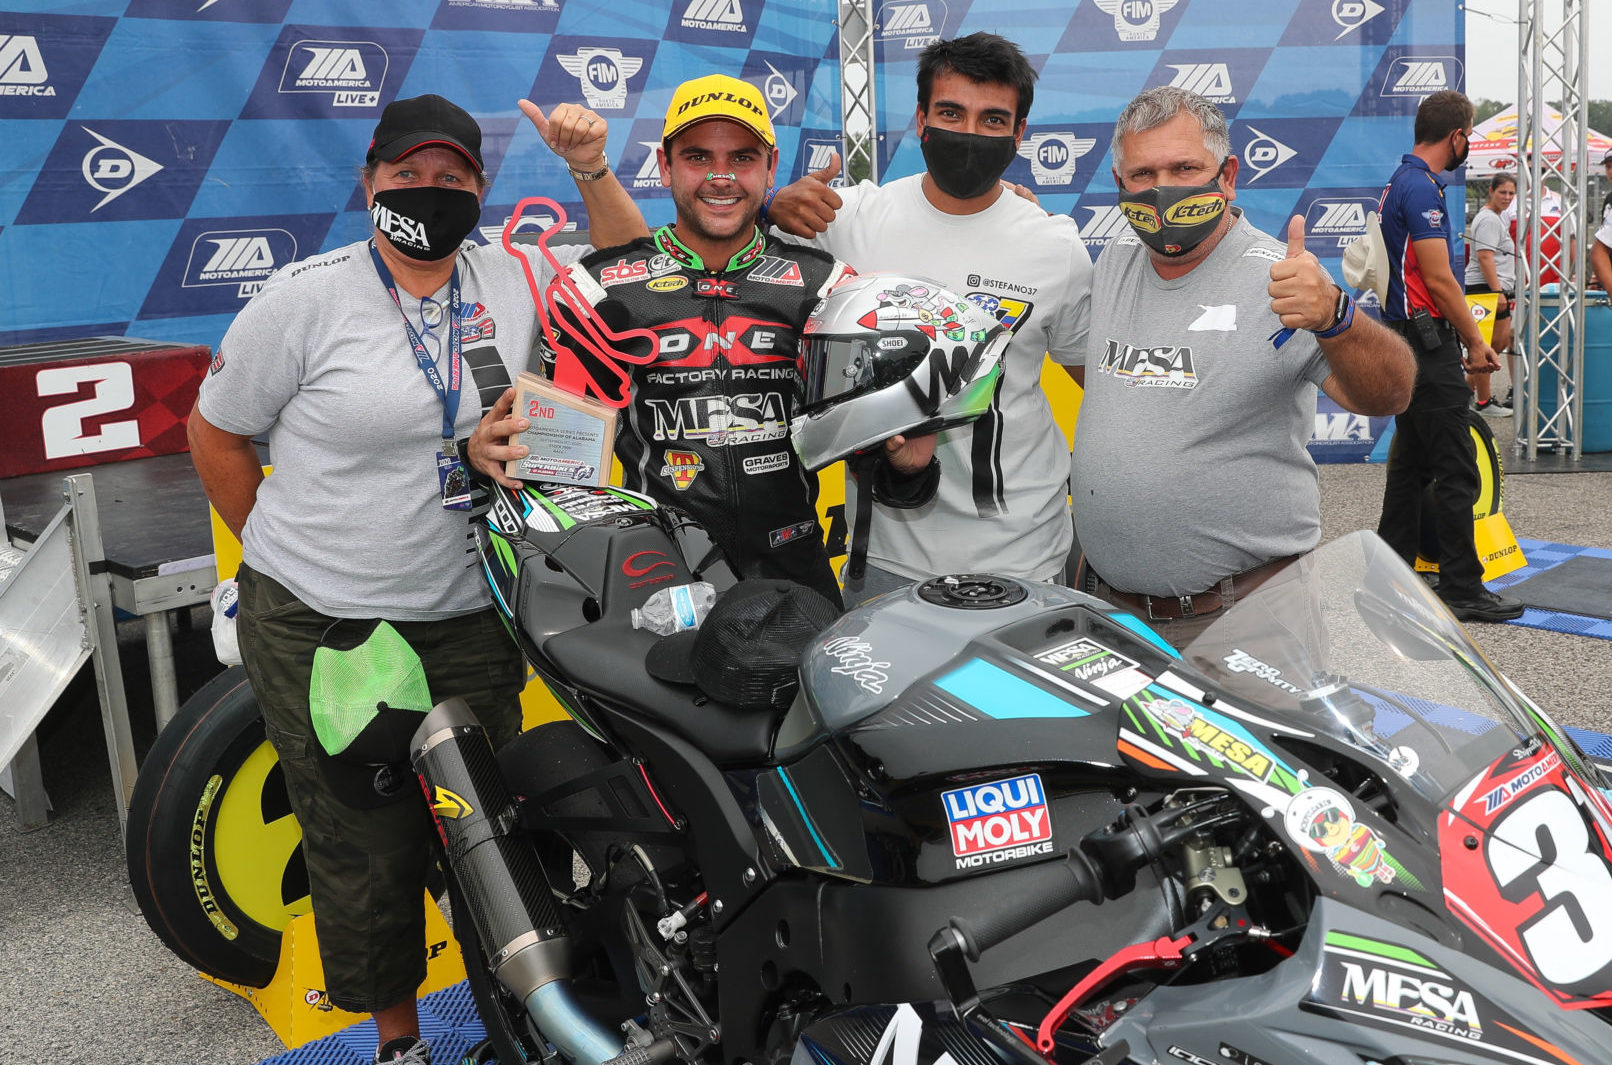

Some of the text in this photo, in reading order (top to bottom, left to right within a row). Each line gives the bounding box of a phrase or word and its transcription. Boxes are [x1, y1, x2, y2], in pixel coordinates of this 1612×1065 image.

[1123, 0, 1150, 18] FIM
[681, 19, 747, 32] MOTOAMERICA
[881, 26, 934, 36] MOTOAMERICA
[295, 79, 372, 88] MOTOAMERICA
[588, 62, 618, 84] FIM
[676, 91, 764, 118] DUNLOP
[1039, 145, 1067, 164] FIM
[370, 201, 431, 248] MESA
[291, 255, 350, 278] DUNLOP
[601, 259, 648, 283] sbs
[748, 275, 804, 286] MOTOAMERICA
[982, 278, 1038, 296] @STEFANO37
[659, 331, 776, 351] ONE
[881, 339, 905, 349] SHOEI
[1098, 337, 1197, 379] MESA
[647, 367, 794, 384] FACTORY RACING
[1137, 377, 1196, 389] RACING
[36, 361, 141, 461] 2
[529, 399, 556, 419] 2ND
[645, 393, 788, 441] MESA
[729, 430, 787, 445] RACING
[745, 453, 789, 467] GRAVES
[746, 461, 789, 473] MOTORSPORTS
[1488, 545, 1518, 562] DUNLOP
[1040, 642, 1097, 665] MESA
[1074, 656, 1123, 681] Ninja
[1186, 715, 1271, 777] MESA
[946, 776, 1042, 820] LIQUI
[956, 808, 1047, 850] MOLY
[190, 808, 219, 914] DUNLOP
[955, 841, 1054, 871] MOTORBIKE
[1340, 960, 1485, 1035] MESA
[1410, 1016, 1483, 1041] RACING
